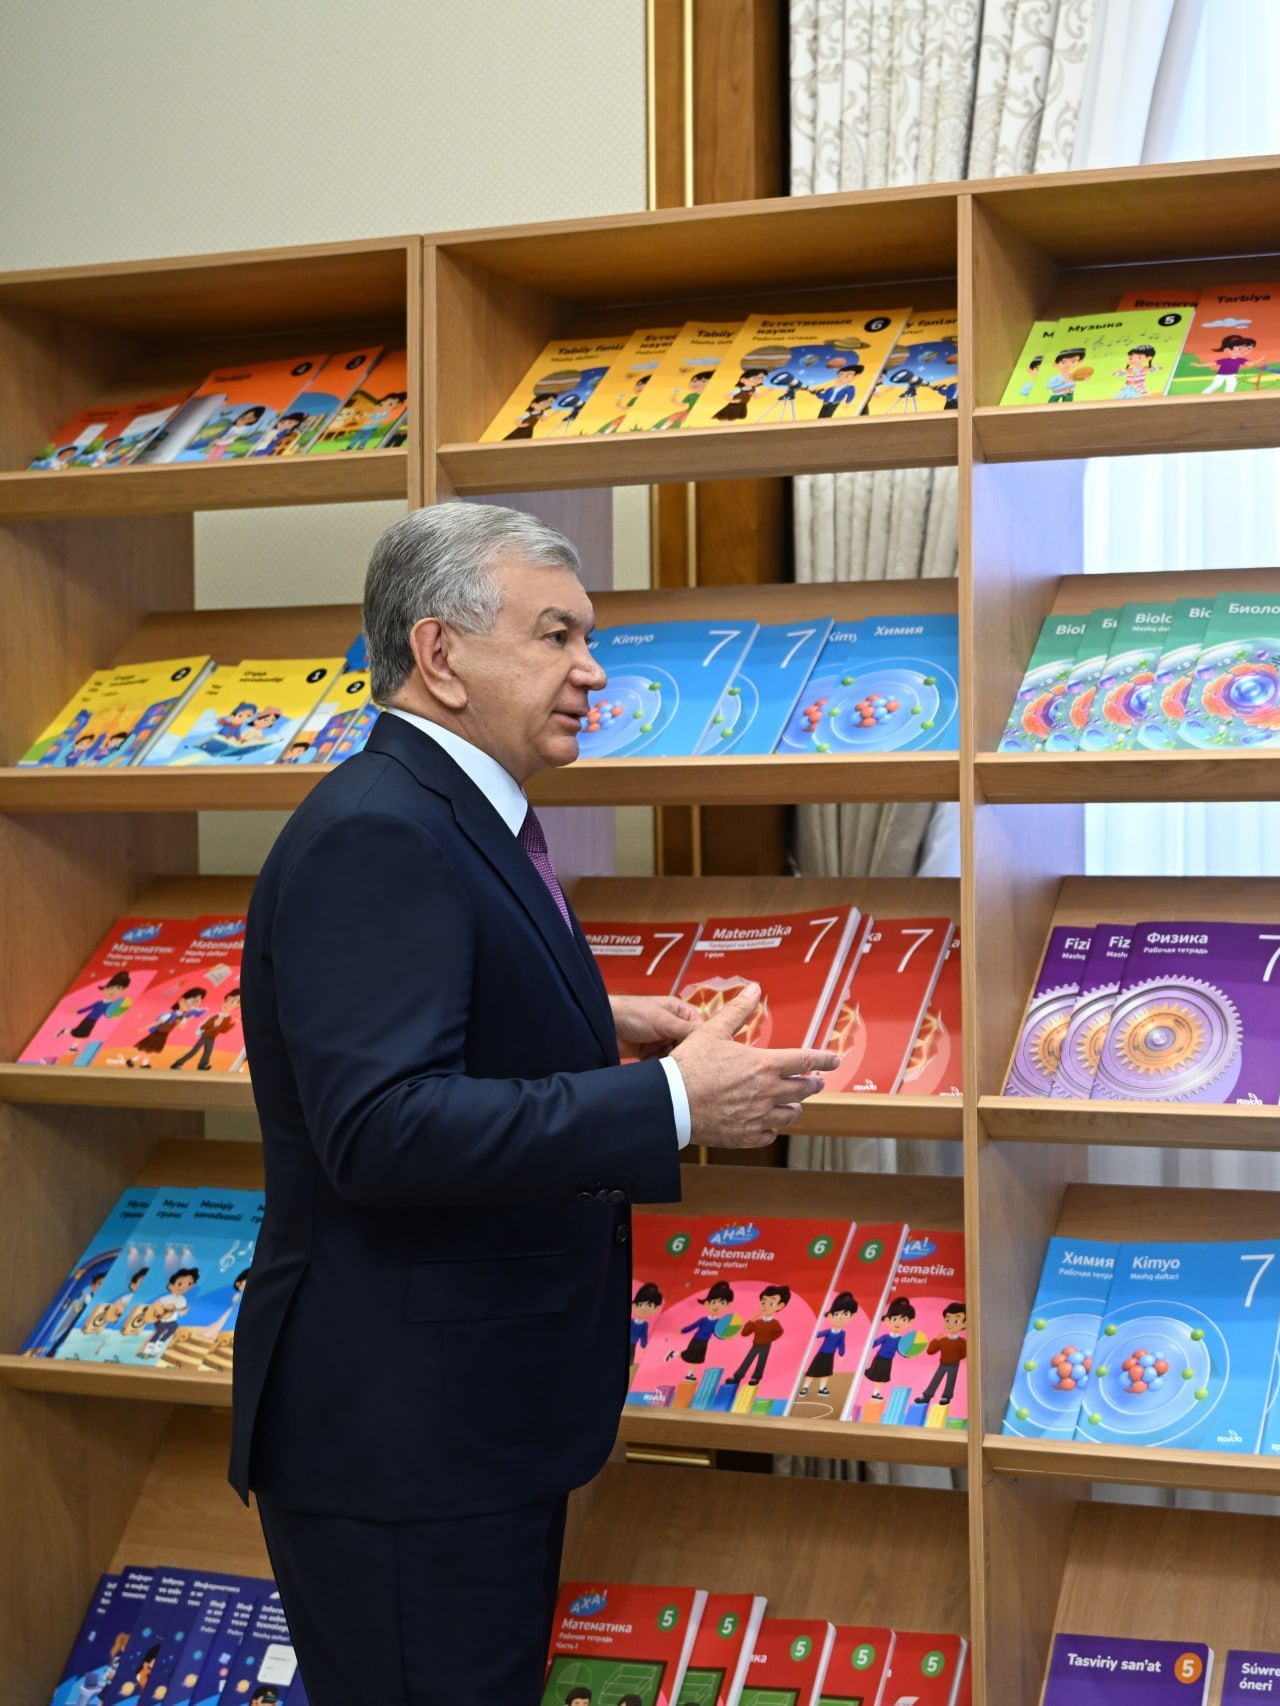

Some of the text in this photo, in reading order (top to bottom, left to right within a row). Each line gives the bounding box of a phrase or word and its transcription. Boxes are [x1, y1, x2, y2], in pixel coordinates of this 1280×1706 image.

[1216, 294, 1271, 304] Tarbiya
[760, 318, 853, 328] Естественные
[871, 320, 884, 331] 6
[1068, 322, 1124, 333] Музыка
[1164, 316, 1176, 325] 5
[697, 330, 734, 340] Tabiiy
[757, 328, 797, 336] науки
[874, 625, 925, 637] Химия
[611, 633, 655, 646] Kimyo
[702, 630, 742, 668] 7
[780, 628, 817, 669] 7
[712, 925, 793, 940] Matematika
[804, 916, 840, 963] 7
[1147, 931, 1209, 945] Физика
[897, 928, 935, 973] 7
[1064, 937, 1092, 950] Fizi
[1143, 946, 1209, 955] Рабочая тетрадь
[646, 933, 684, 976] 7
[1062, 952, 1087, 961] Mashq
[710, 1222, 754, 1245] AHA!
[671, 1237, 687, 1252] 6
[813, 1240, 828, 1255] 6
[865, 1244, 879, 1259] 6
[701, 1247, 775, 1261] Matematika
[1062, 1251, 1115, 1268] Химия
[698, 1259, 749, 1269] Mashq daftari
[1132, 1255, 1181, 1273] Kimyo
[701, 1269, 719, 1277] qism
[900, 1276, 928, 1285] daftari
[1059, 1268, 1092, 1278] Рабочая
[1129, 1272, 1180, 1281] Mashq daftari
[1240, 1254, 1275, 1308] 7
[561, 1618, 633, 1633] Математика
[662, 1610, 675, 1628] 5
[722, 1617, 734, 1633] 5
[559, 1632, 614, 1643] Рабочая тетрадь
[556, 1642, 575, 1650] Часть
[795, 1640, 807, 1656] 5
[857, 1648, 869, 1665] 5
[926, 1656, 938, 1672] 5
[1067, 1653, 1162, 1673] Tasviriy san'at
[1181, 1659, 1195, 1678] 5
[1239, 1677, 1273, 1692] óneri
